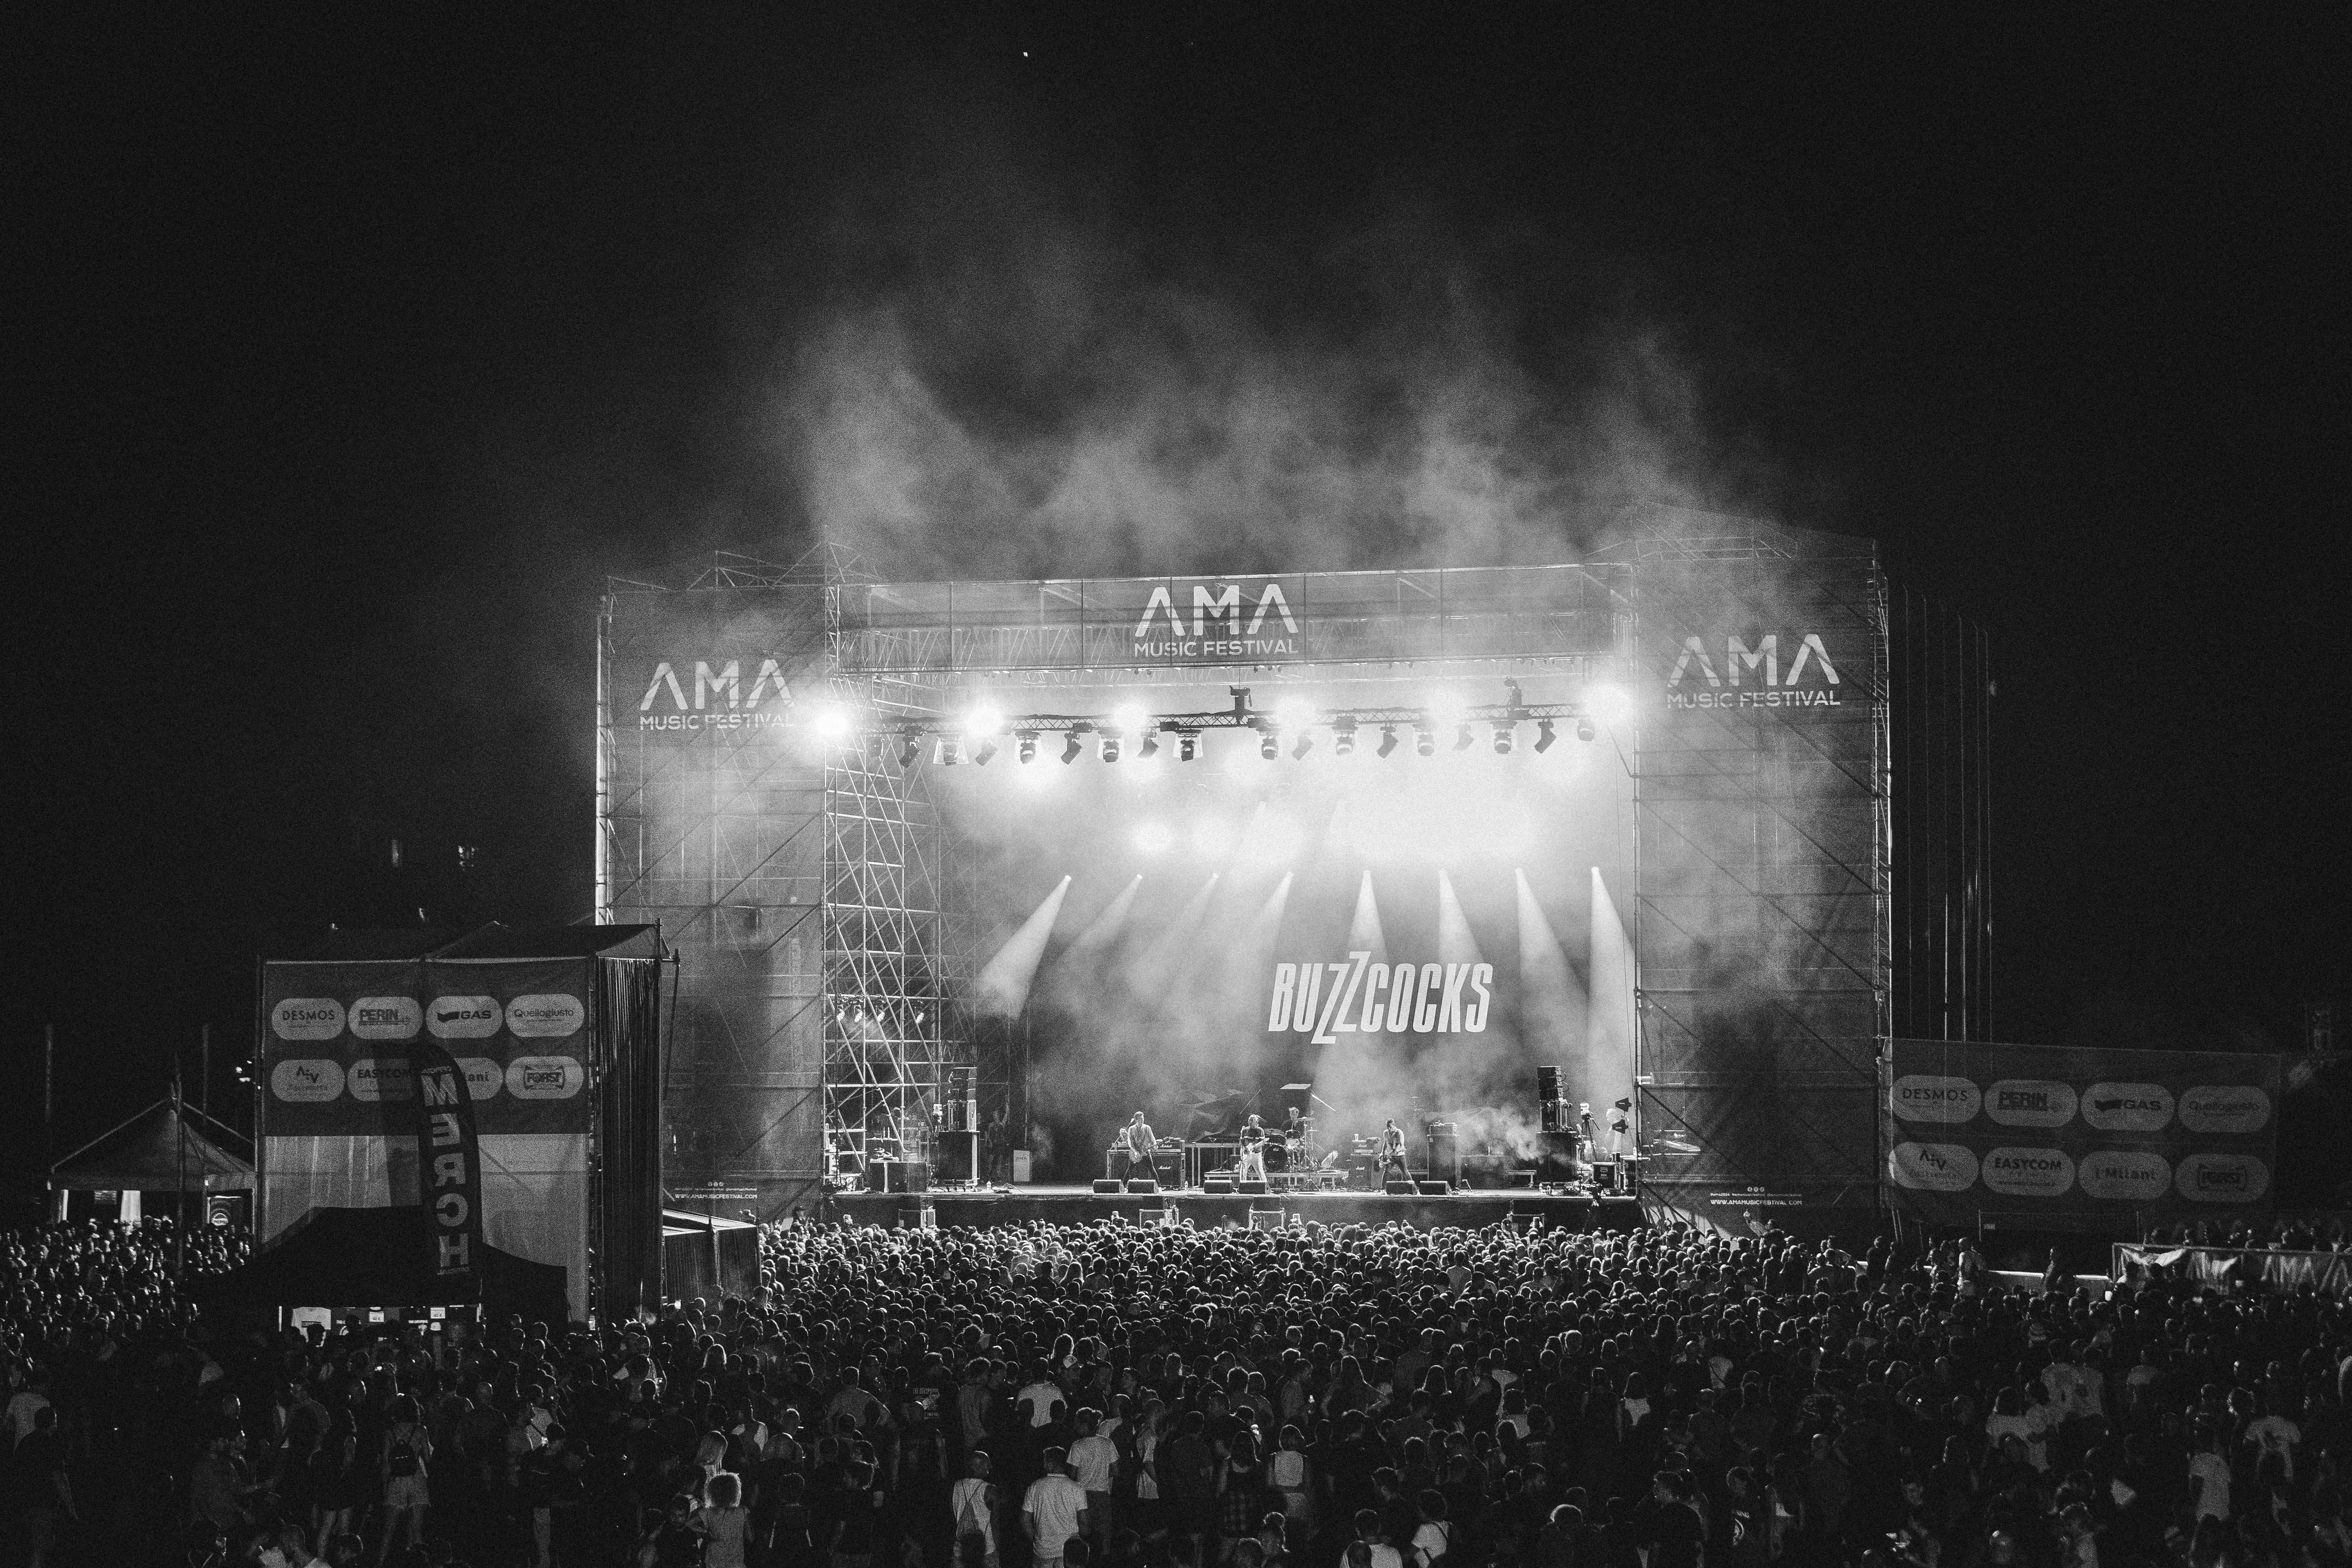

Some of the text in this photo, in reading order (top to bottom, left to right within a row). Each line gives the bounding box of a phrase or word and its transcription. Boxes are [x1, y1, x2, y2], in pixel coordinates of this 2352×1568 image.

[1135, 584, 1299, 637] AMA
[1134, 639, 1299, 657] MUSIC FESTIVAL
[1667, 634, 1840, 688] AMA
[640, 659, 795, 711] AMA
[1667, 690, 1841, 708] MUSIC FESTIVAL
[640, 711, 795, 731] MUSIC FESTIVAL
[1268, 951, 1493, 1044] BUZZCOCKS
[282, 1009, 336, 1020] DESMOS
[359, 1008, 399, 1020] PERIN
[460, 1010, 492, 1020] GAS
[514, 1008, 574, 1018] Quellogiusto
[1903, 1088, 1968, 1101] DESMOS
[1998, 1091, 2048, 1107] PERIN
[2124, 1100, 2162, 1111] GAS
[1994, 1157, 2062, 1171] EASYCOM
[2105, 1165, 2156, 1180] Milani
